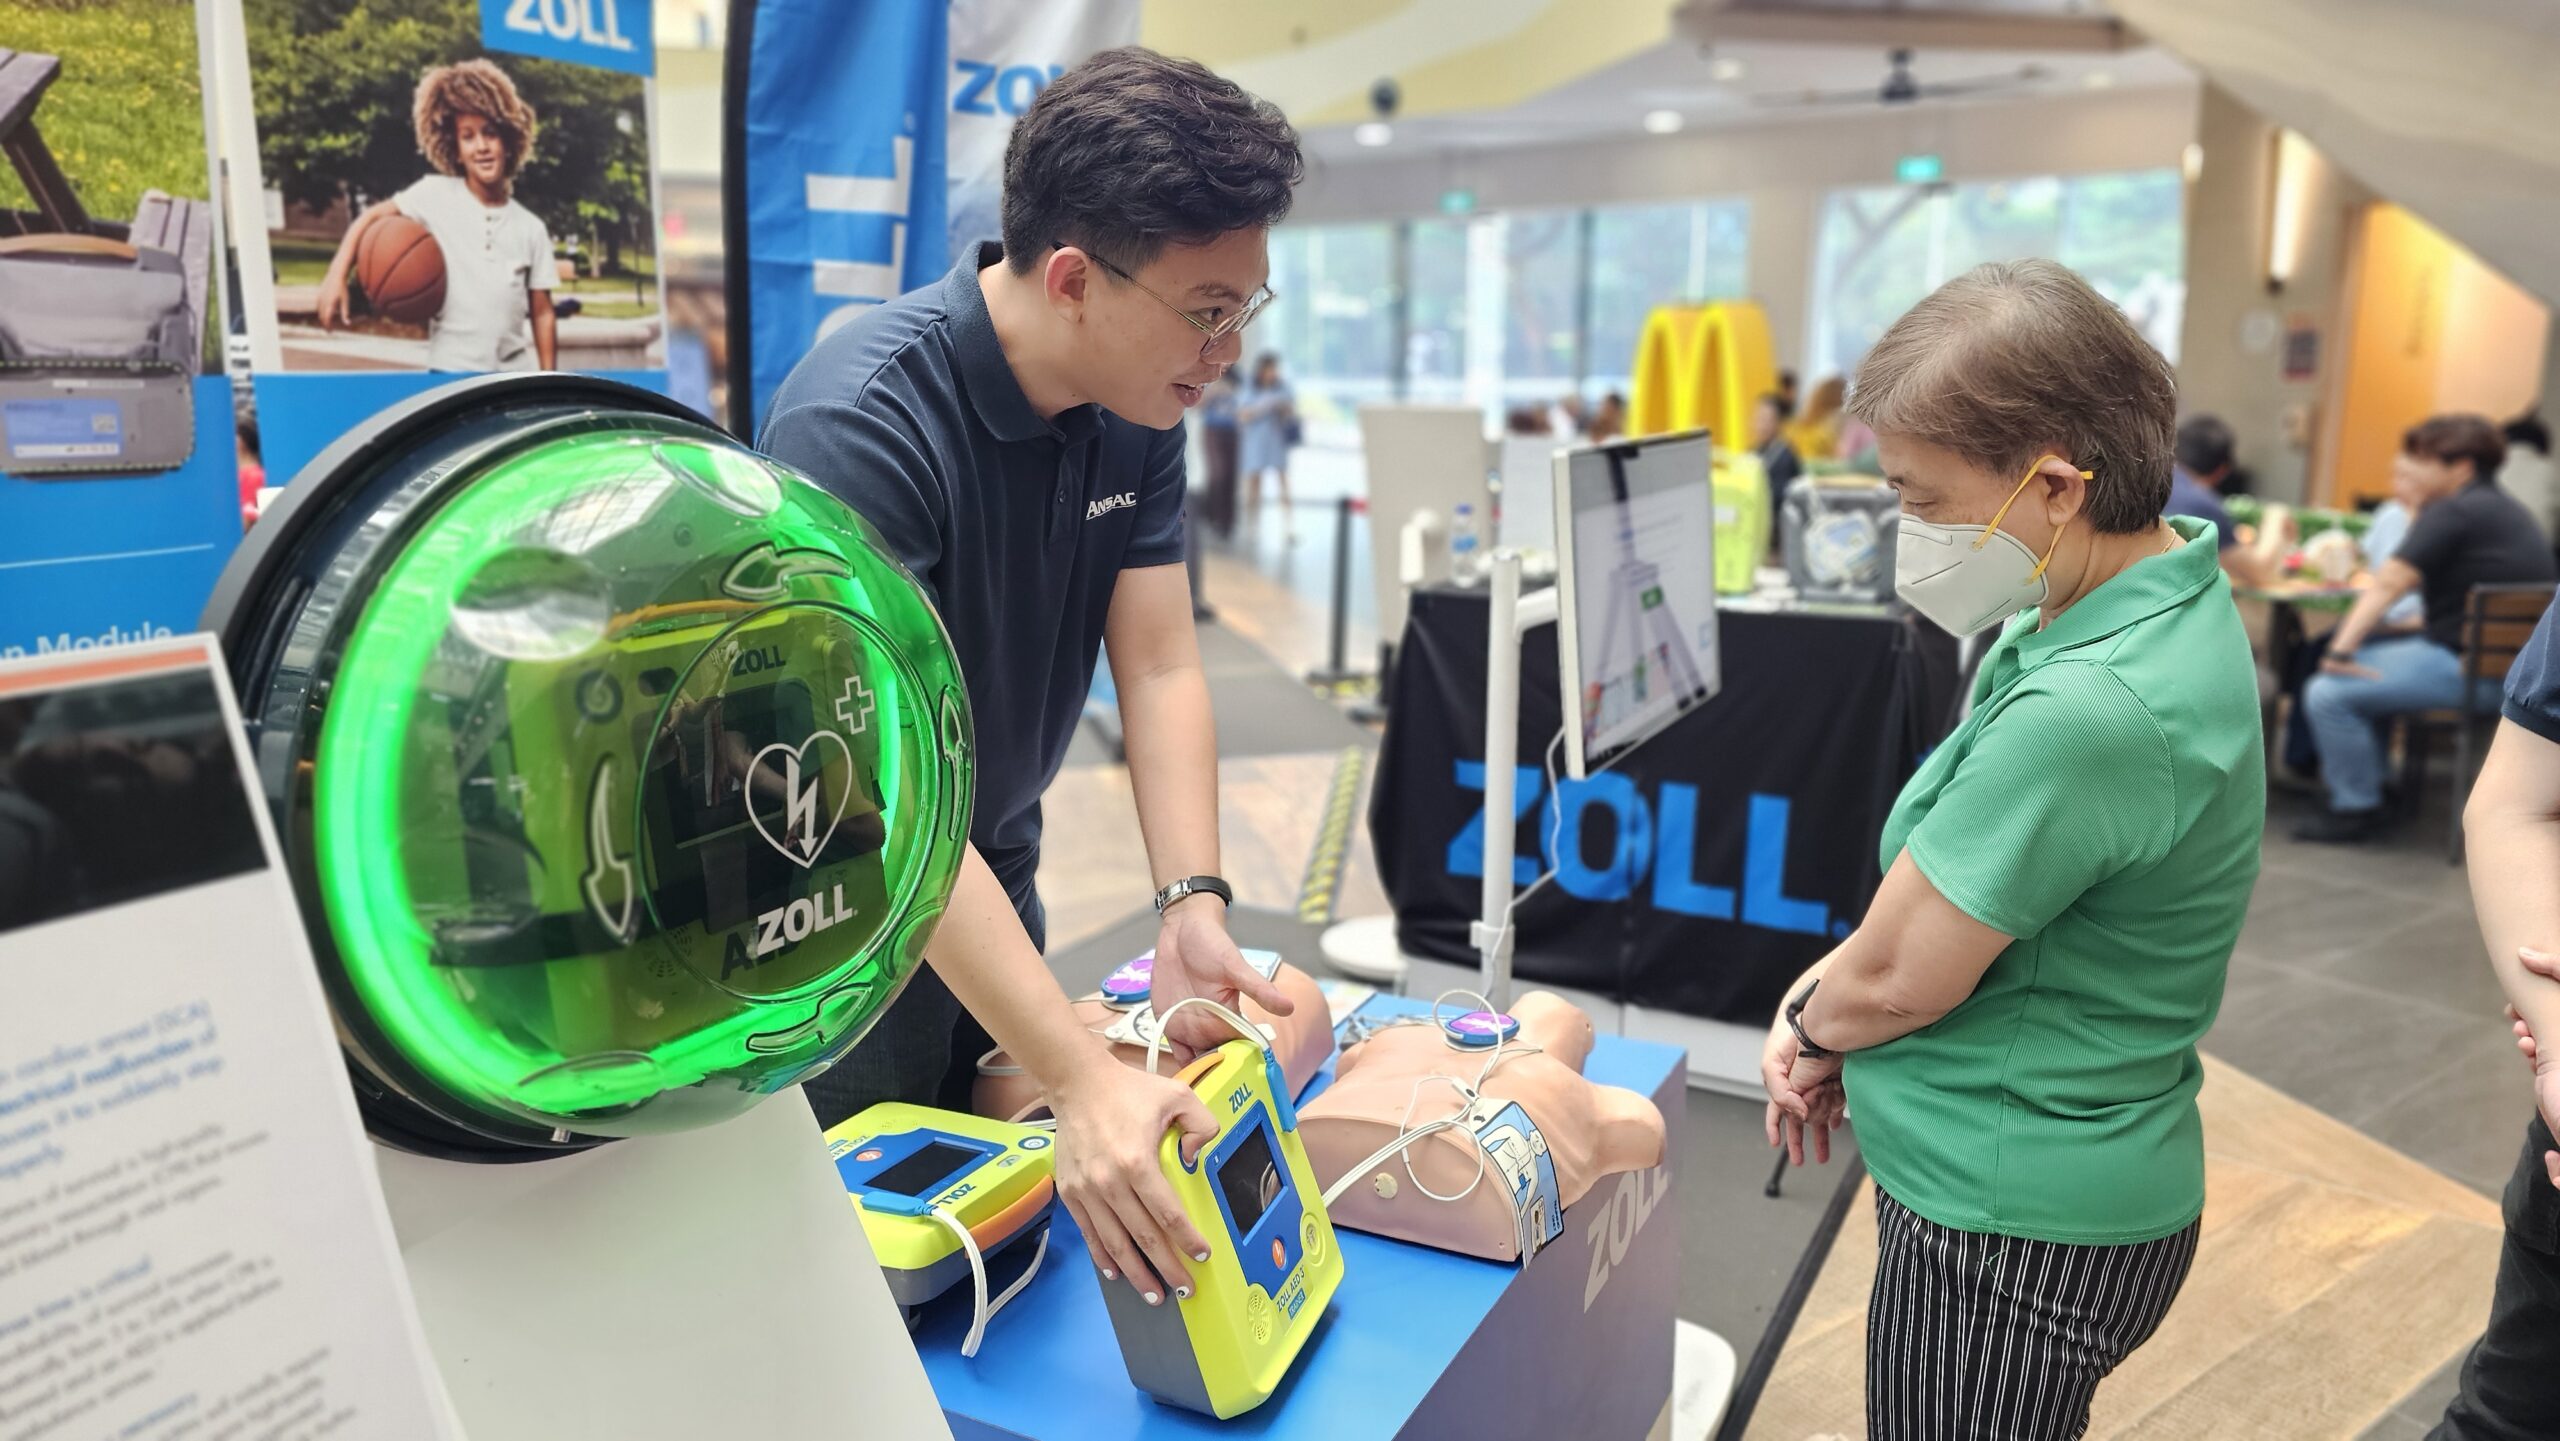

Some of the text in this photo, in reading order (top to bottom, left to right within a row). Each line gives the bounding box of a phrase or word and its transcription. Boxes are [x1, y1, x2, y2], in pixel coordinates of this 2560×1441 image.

[953, 59, 1064, 117] ZO
[1086, 492, 1137, 520] ANSAC
[732, 645, 787, 677] ZOLL
[1446, 758, 1830, 936] ZOLL
[757, 883, 853, 956] ZOLL
[1229, 1082, 1252, 1114] ZOLL
[935, 1183, 977, 1205] ZOLL
[1584, 1168, 1668, 1314] ZOLL
[1290, 1273, 1301, 1293] AED
